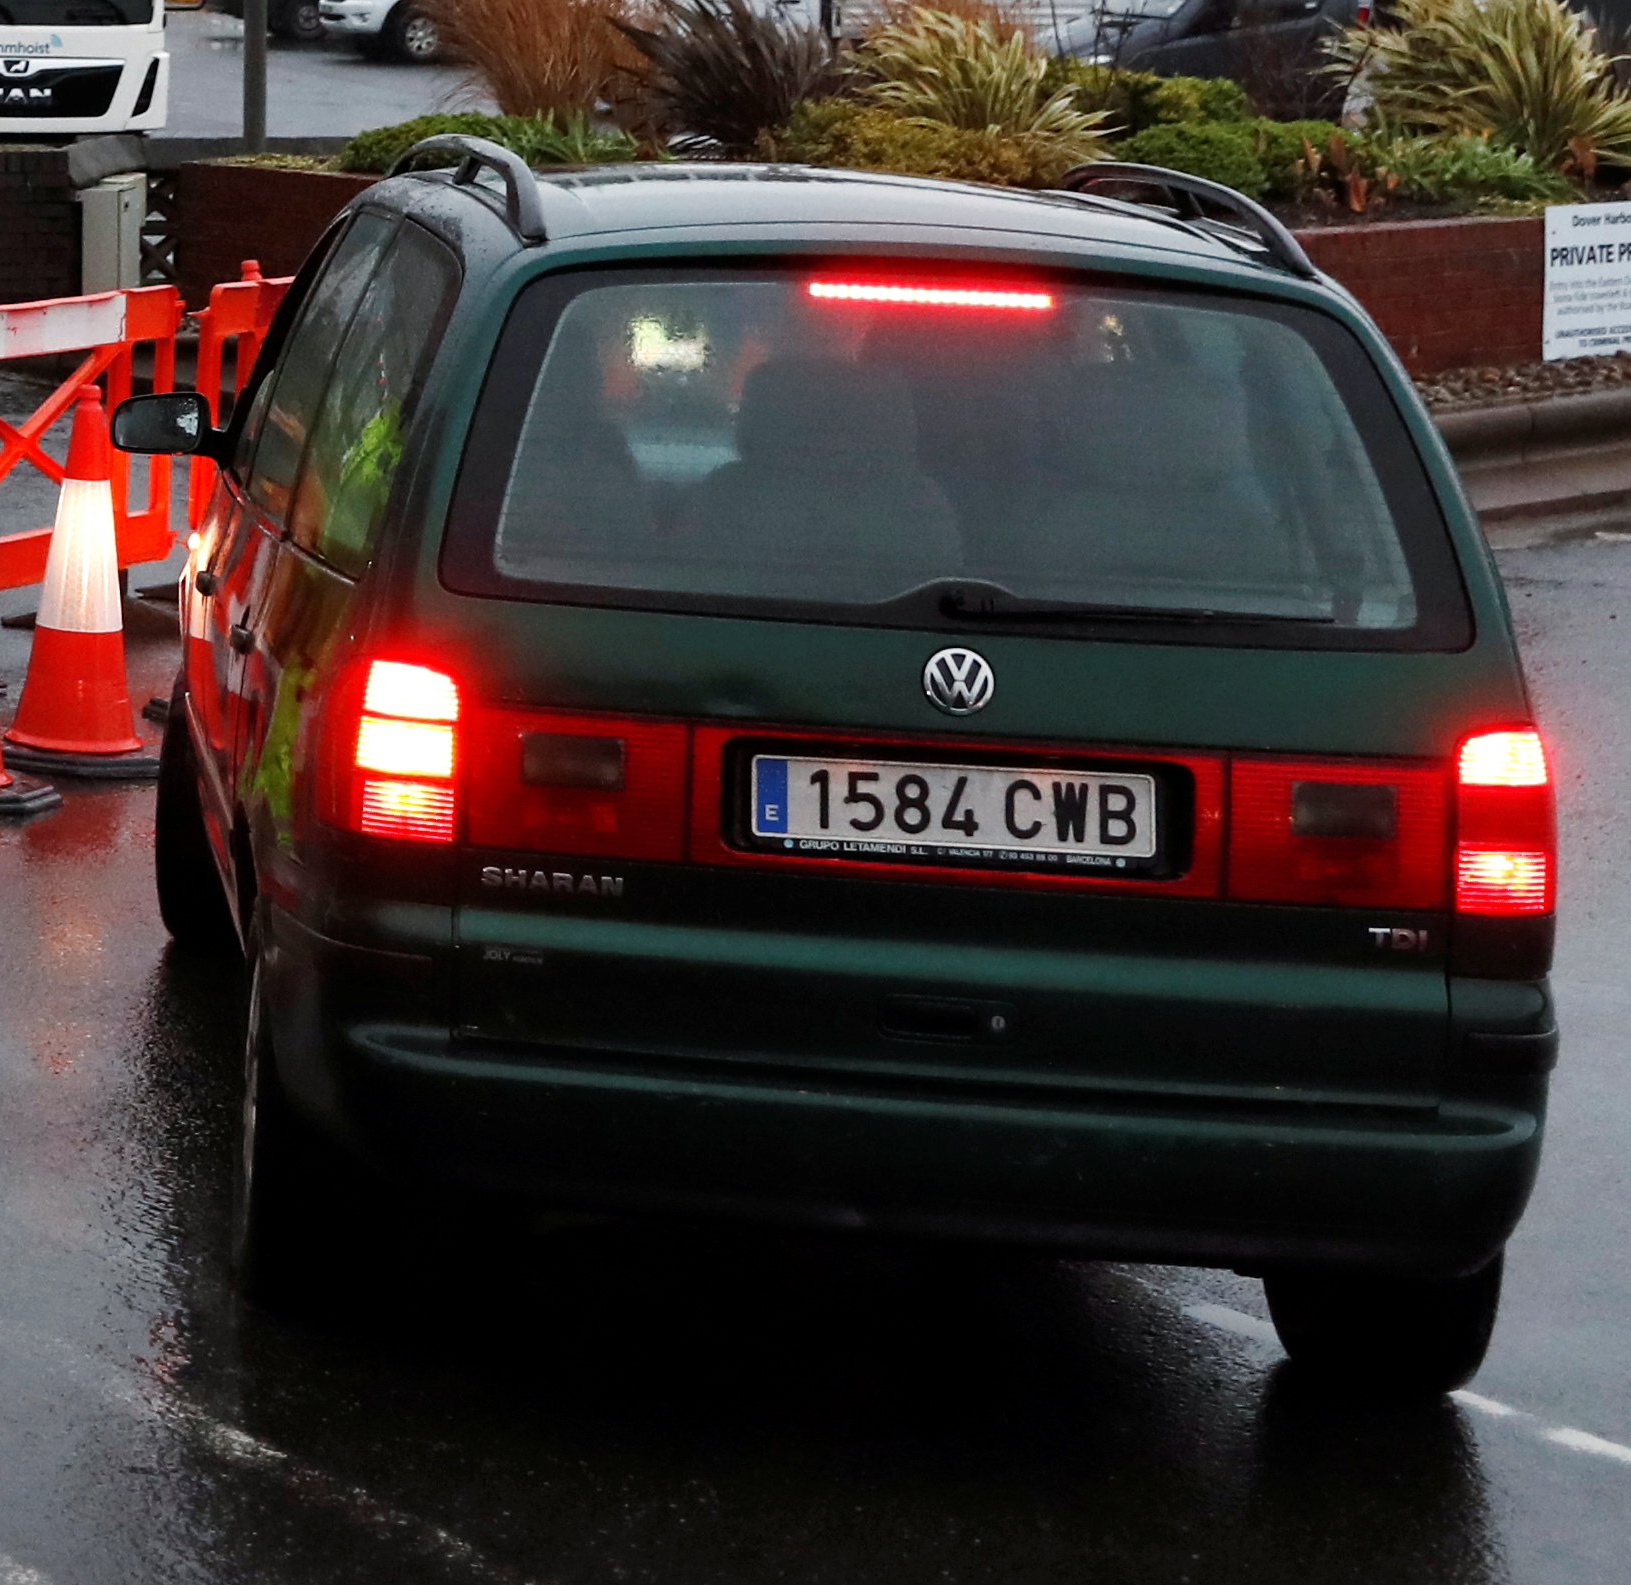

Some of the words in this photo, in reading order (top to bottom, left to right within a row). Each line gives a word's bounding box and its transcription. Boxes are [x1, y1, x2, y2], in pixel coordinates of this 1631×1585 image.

[1572, 215, 1601, 227] Dover
[1549, 243, 1614, 267] PRIVATE
[765, 804, 780, 821] E
[810, 769, 980, 837] 1584
[1004, 779, 1137, 846] CWB
[799, 840, 840, 851] GRUPO
[843, 842, 906, 854] LETAMENDI
[911, 846, 928, 855] S.L.
[948, 848, 982, 857] VALENCIA
[1065, 855, 1112, 866] BARCELONA
[481, 866, 625, 897] SHARAN
[1368, 927, 1428, 952] TDI
